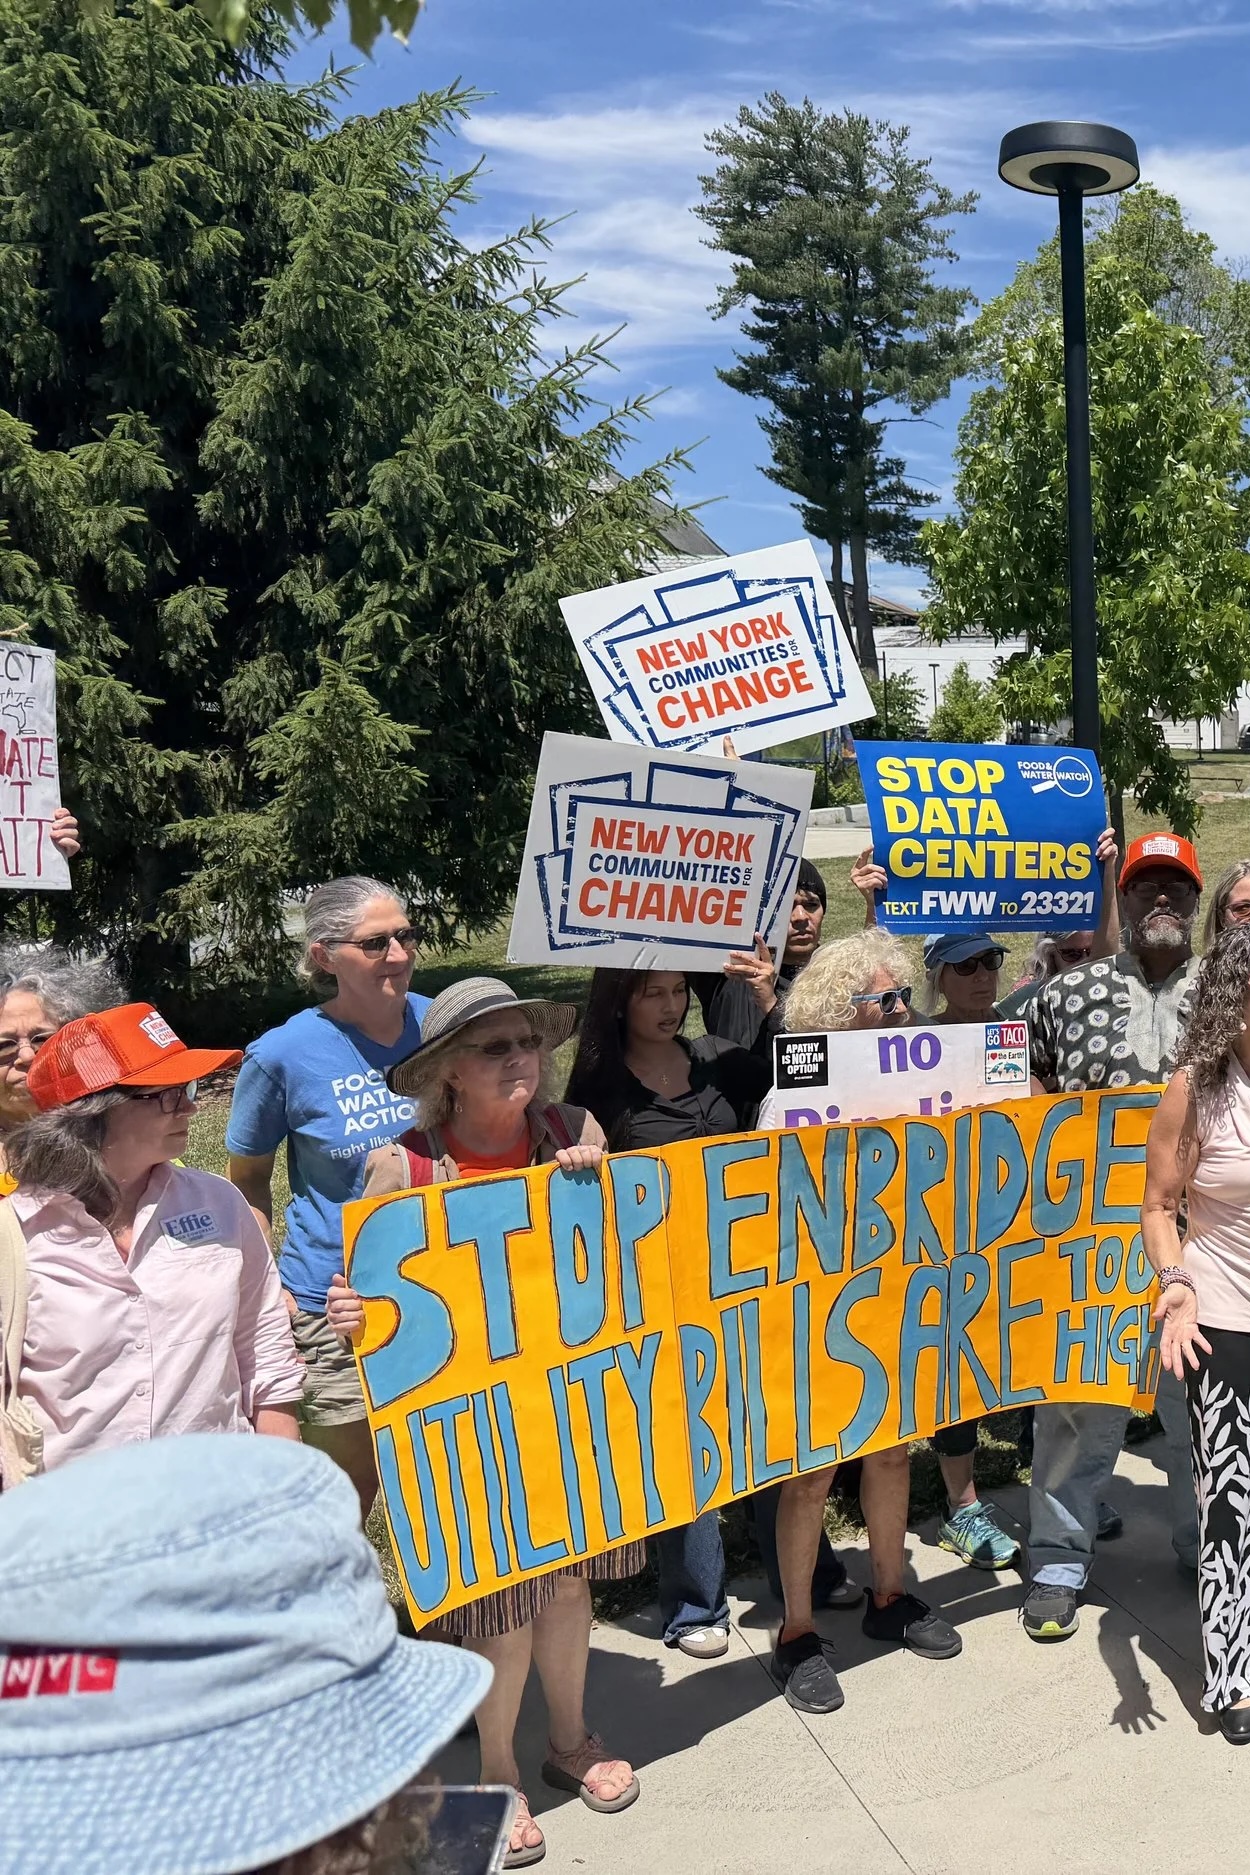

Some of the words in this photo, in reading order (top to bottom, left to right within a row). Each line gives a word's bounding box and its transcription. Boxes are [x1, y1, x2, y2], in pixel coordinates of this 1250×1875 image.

[636, 631, 708, 675] NEW
[708, 611, 793, 653] YORK
[649, 643, 789, 694] COMMUNITIES
[787, 638, 801, 656] FOR
[656, 659, 814, 729] CHANGE
[876, 757, 1005, 794] STOP
[1021, 770, 1054, 780] WATER
[1056, 772, 1089, 781] WATCH
[882, 796, 1009, 836] DATA
[590, 817, 671, 855] NEW
[676, 826, 755, 863] YORK
[588, 853, 741, 885] COMMUNITIES
[742, 867, 753, 886] FOR
[888, 838, 1092, 880] CENTERS
[578, 877, 747, 927] CHANGE
[883, 902, 919, 915] TEXT
[922, 890, 997, 915] FWW
[1000, 903, 1018, 915] TO
[1020, 891, 1095, 915] 23321
[786, 1042, 819, 1054] APATHY
[878, 1032, 942, 1074] no
[987, 1035, 1000, 1046] GO
[1001, 1027, 1025, 1045] TACO
[781, 1054, 791, 1065] IS
[791, 1052, 812, 1065] NOT
[812, 1052, 824, 1062] AN
[787, 1063, 819, 1075] OPTION
[332, 1069, 383, 1097] FOO
[344, 1101, 420, 1136] ACTIO
[330, 1143, 367, 1160] Fight
[369, 1134, 392, 1149] like
[164, 1213, 214, 1238] Effie
[350, 1153, 671, 1412] STOP
[702, 1092, 1161, 1300] ENBRIDGE
[1059, 1231, 1154, 1302] TOO
[1054, 1303, 1161, 1394] HIGH
[374, 1331, 665, 1613] UTILITY
[678, 1267, 889, 1516] BILLS
[899, 1238, 1048, 1440] ARE
[6, 1653, 108, 1687] NYC
